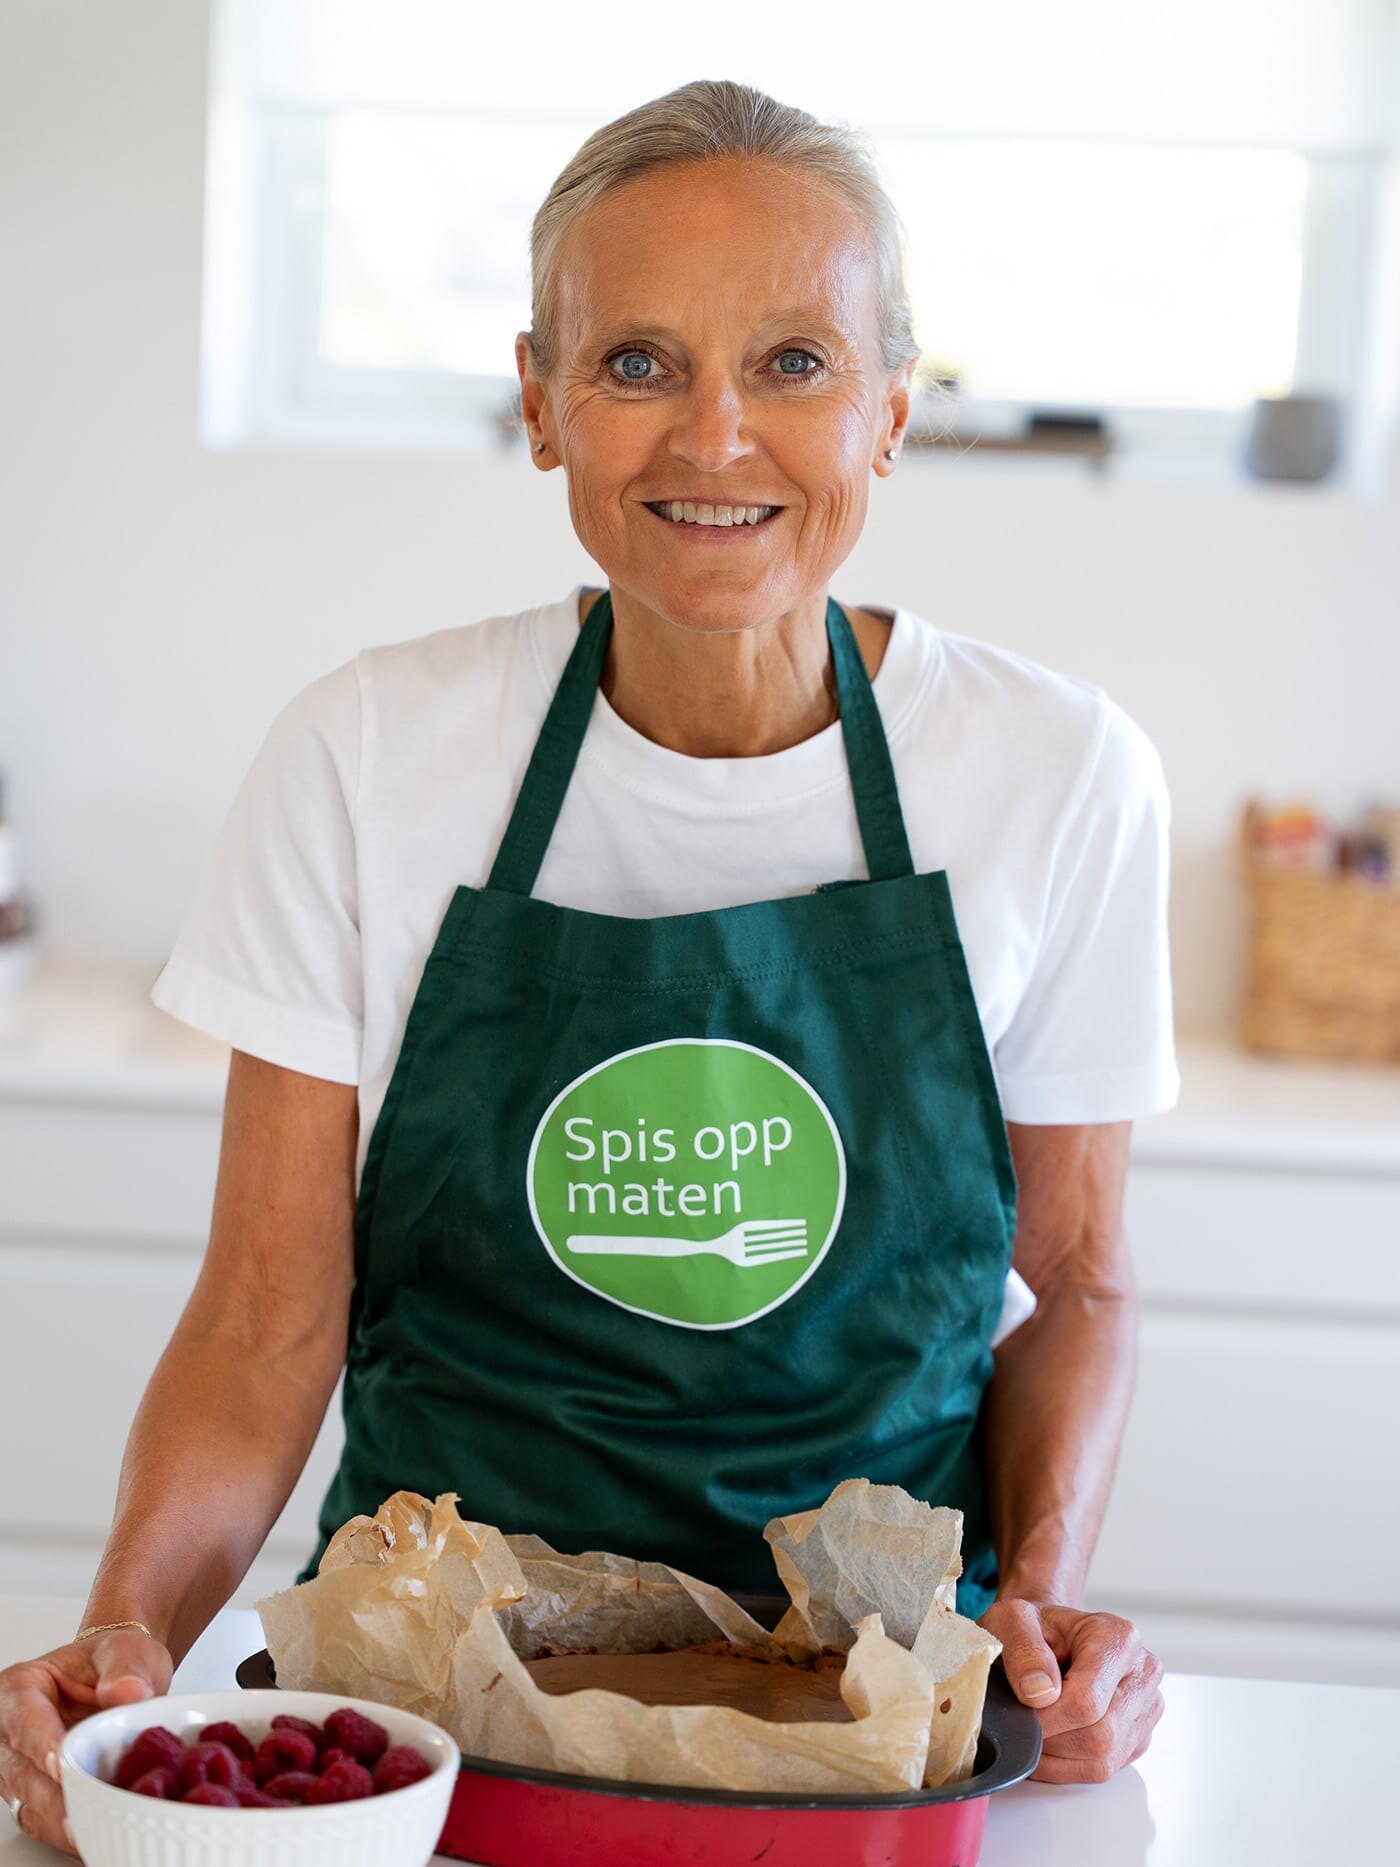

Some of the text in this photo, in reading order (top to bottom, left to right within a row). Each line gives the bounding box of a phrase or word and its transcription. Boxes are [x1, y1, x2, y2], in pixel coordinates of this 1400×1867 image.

[564, 1116, 793, 1174] Spis opp
[567, 1178, 742, 1217] maten
